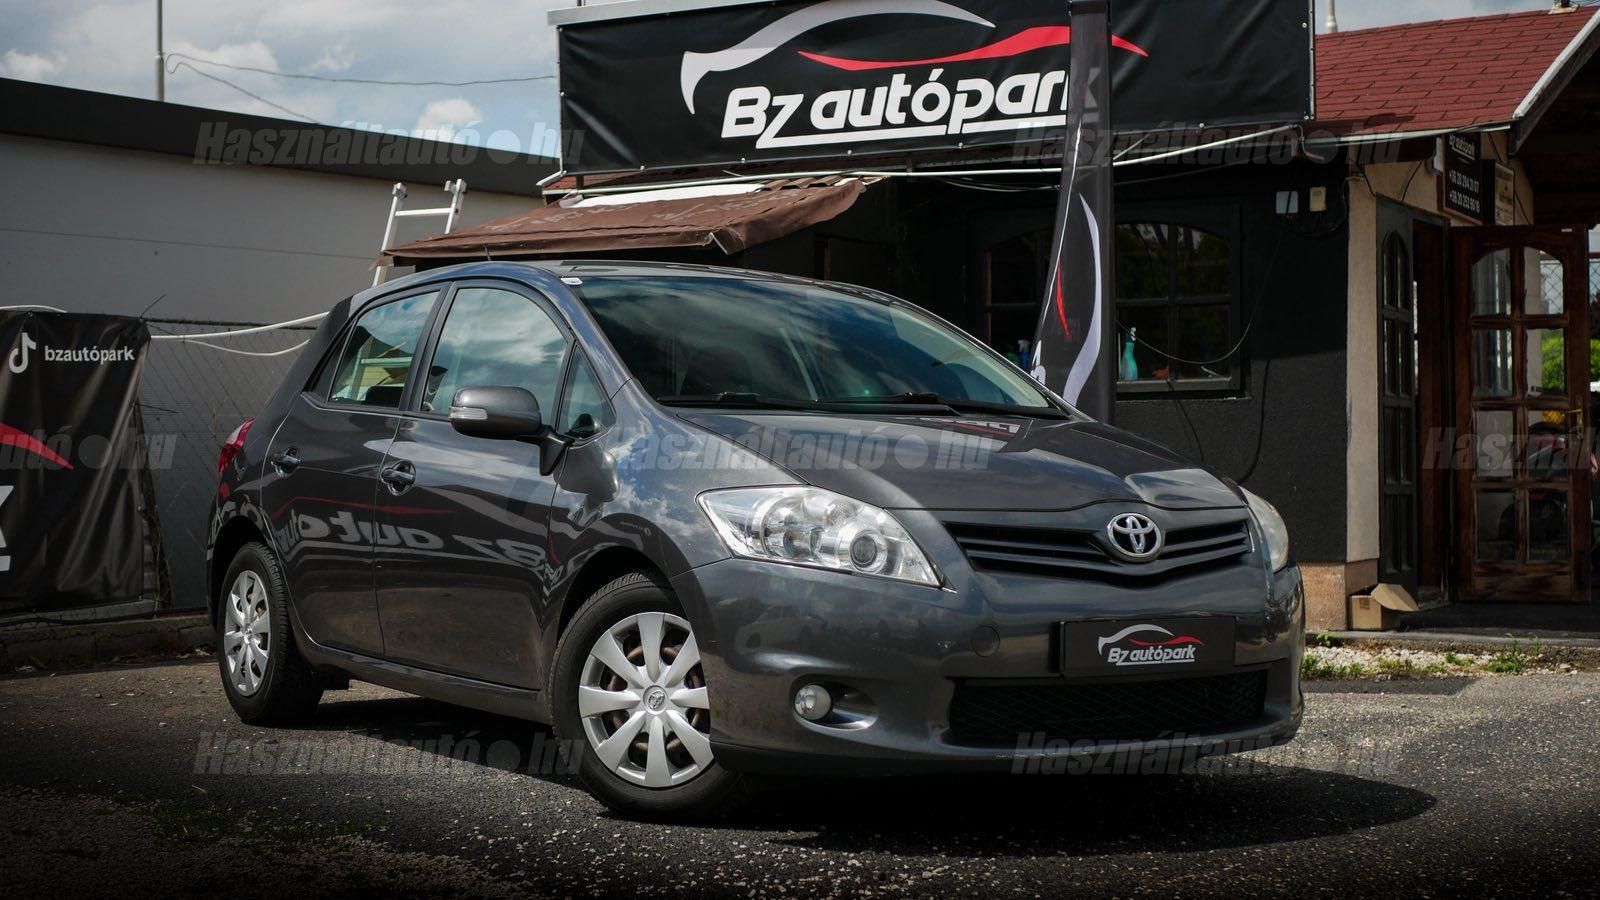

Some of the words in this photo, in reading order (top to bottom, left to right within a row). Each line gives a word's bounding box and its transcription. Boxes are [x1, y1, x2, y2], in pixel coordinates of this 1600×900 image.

[721, 85, 805, 150] Bz
[44, 344, 135, 365] bzautópark
[1107, 647, 1130, 666] Bz
[1129, 644, 1197, 664] autópark
